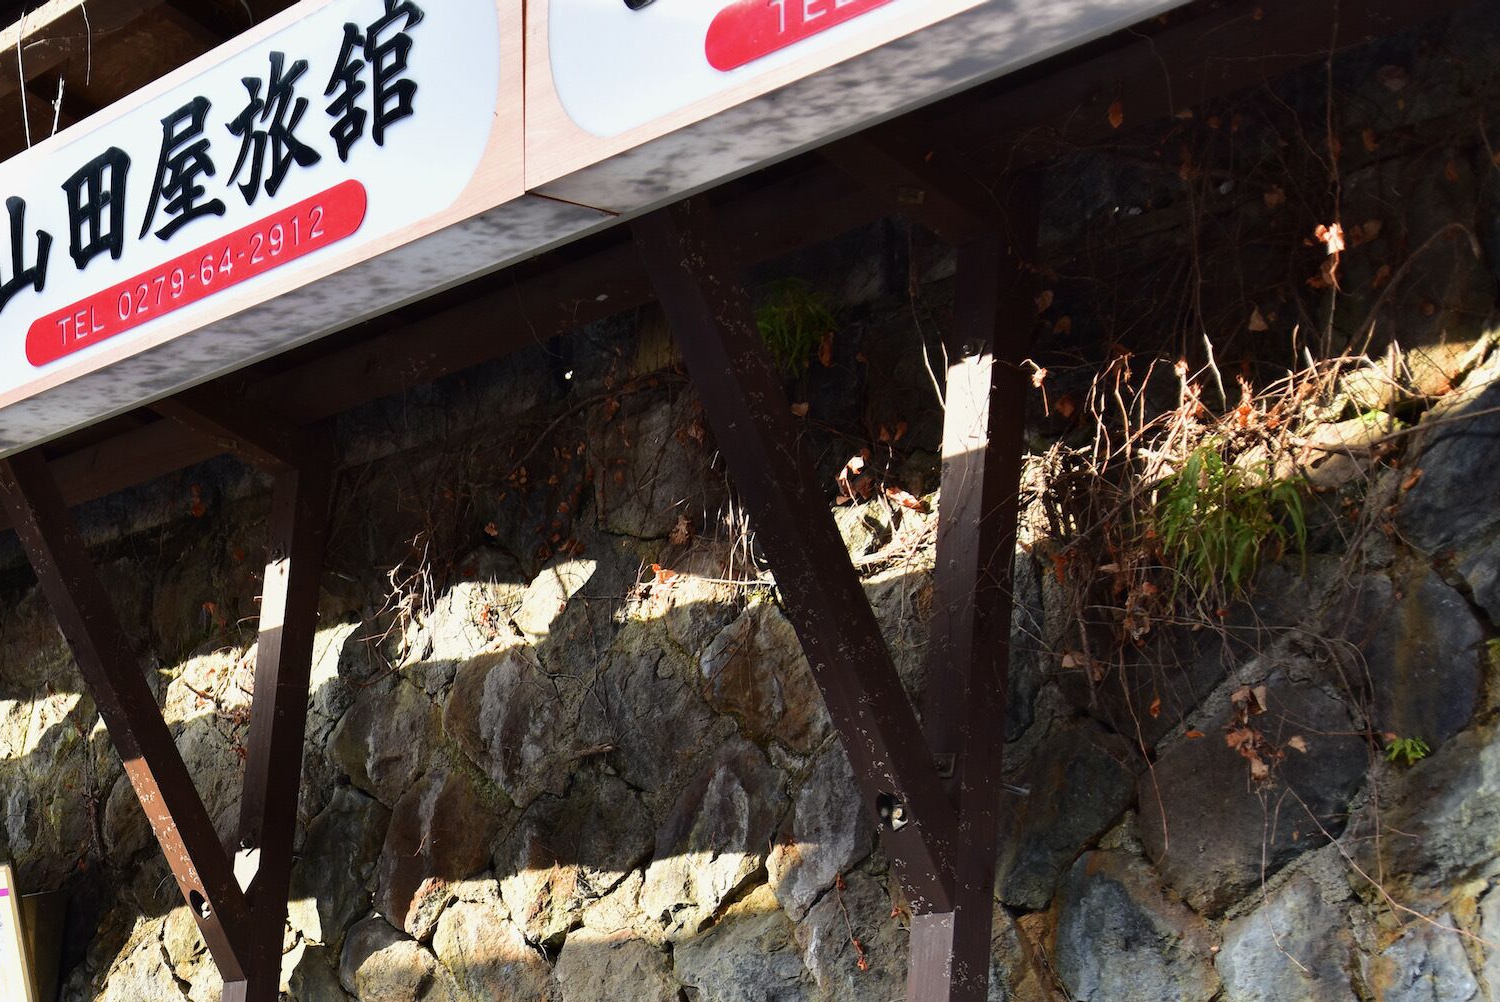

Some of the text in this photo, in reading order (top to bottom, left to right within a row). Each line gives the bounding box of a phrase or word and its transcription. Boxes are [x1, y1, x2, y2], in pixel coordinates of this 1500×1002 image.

[767, 0, 846, 34] TE
[57, 205, 325, 346] TEL 0279-64-2912
